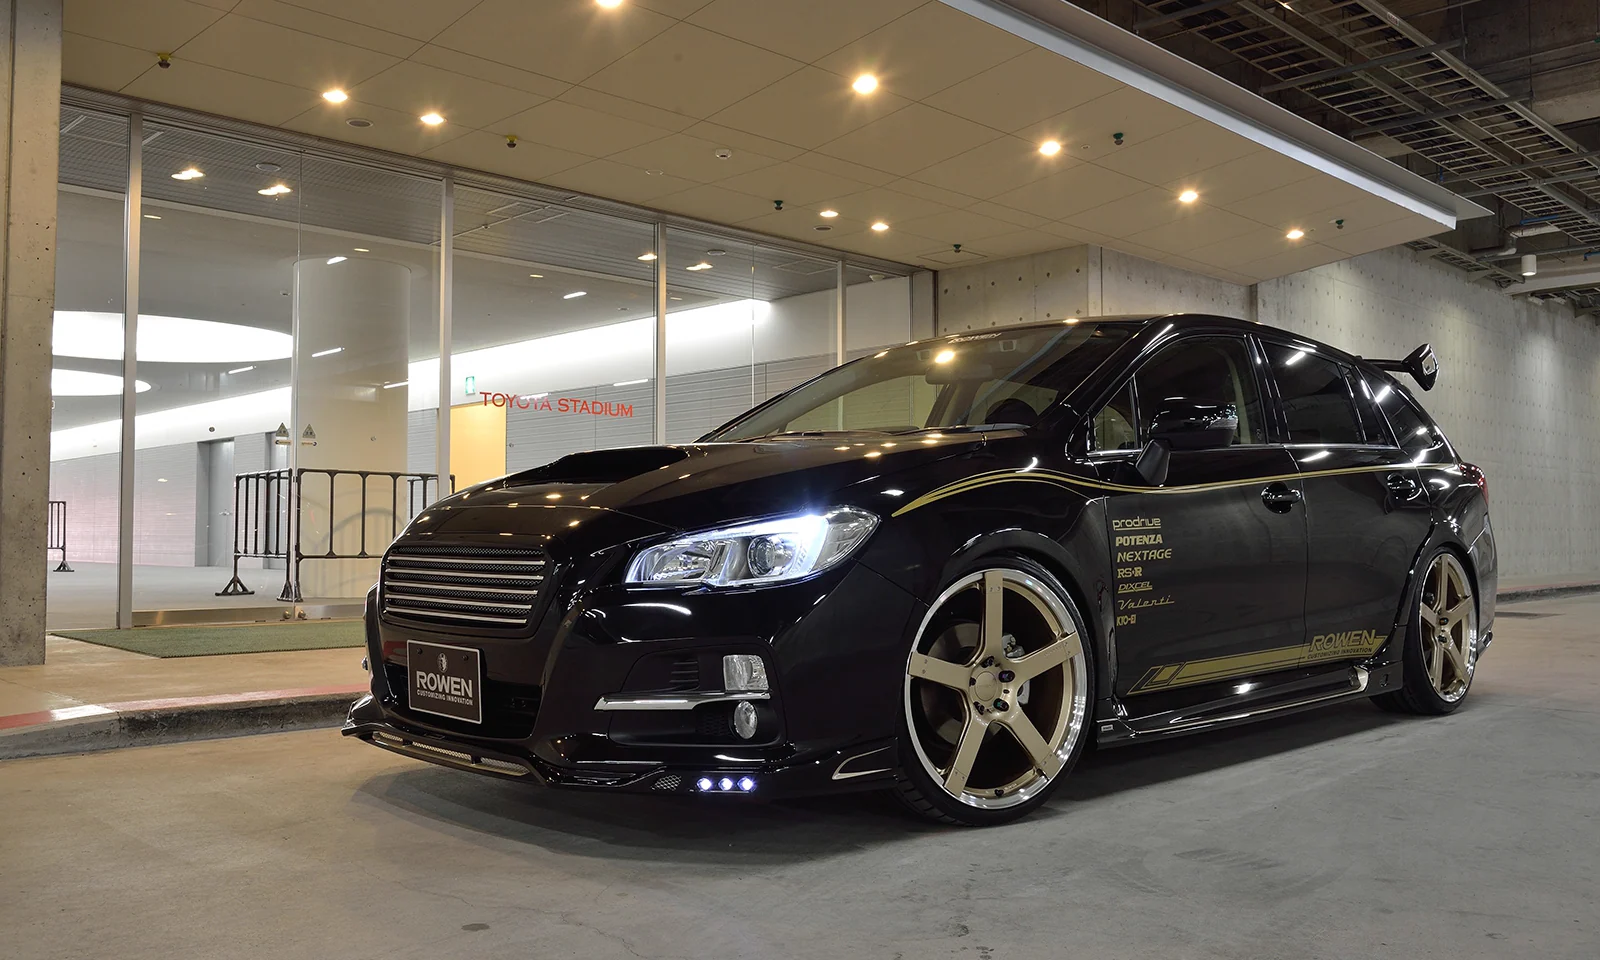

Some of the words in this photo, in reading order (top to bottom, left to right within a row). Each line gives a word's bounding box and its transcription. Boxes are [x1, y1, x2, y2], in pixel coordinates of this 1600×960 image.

[479, 391, 552, 411] TOYOTA
[557, 397, 633, 418] STADIUM
[1112, 516, 1162, 531] prodrive
[1115, 534, 1163, 547] POTENZA
[1116, 548, 1172, 563] NEXTAGE
[1118, 581, 1153, 594] DIXCEL
[1117, 595, 1175, 610] Valenti
[1309, 629, 1376, 651] ROWEN
[1307, 649, 1340, 659] CUSTOMIZING
[1340, 647, 1372, 655] INNOVATION
[416, 670, 473, 698] ROWEN
[416, 689, 446, 701] CUSTOMIZING
[446, 694, 473, 706] INNOVATION
